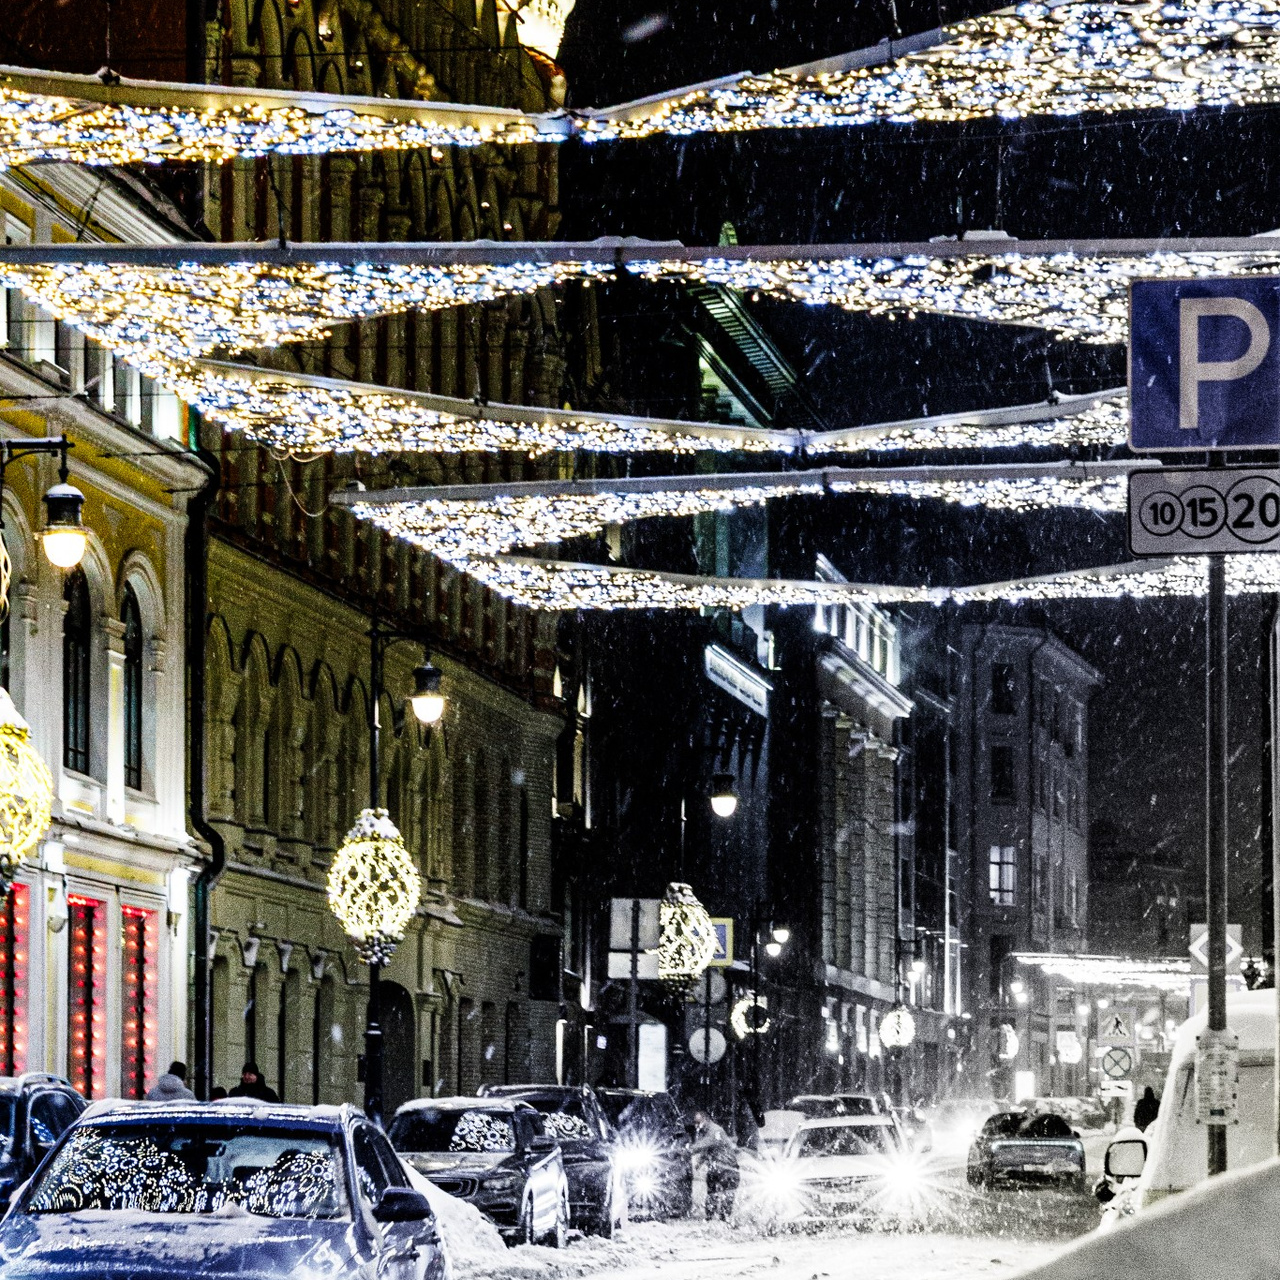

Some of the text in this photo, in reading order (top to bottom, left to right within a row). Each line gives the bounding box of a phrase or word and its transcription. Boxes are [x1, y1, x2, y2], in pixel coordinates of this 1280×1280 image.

[1178, 296, 1271, 429] P
[1148, 492, 1280, 530] 10 15 20
